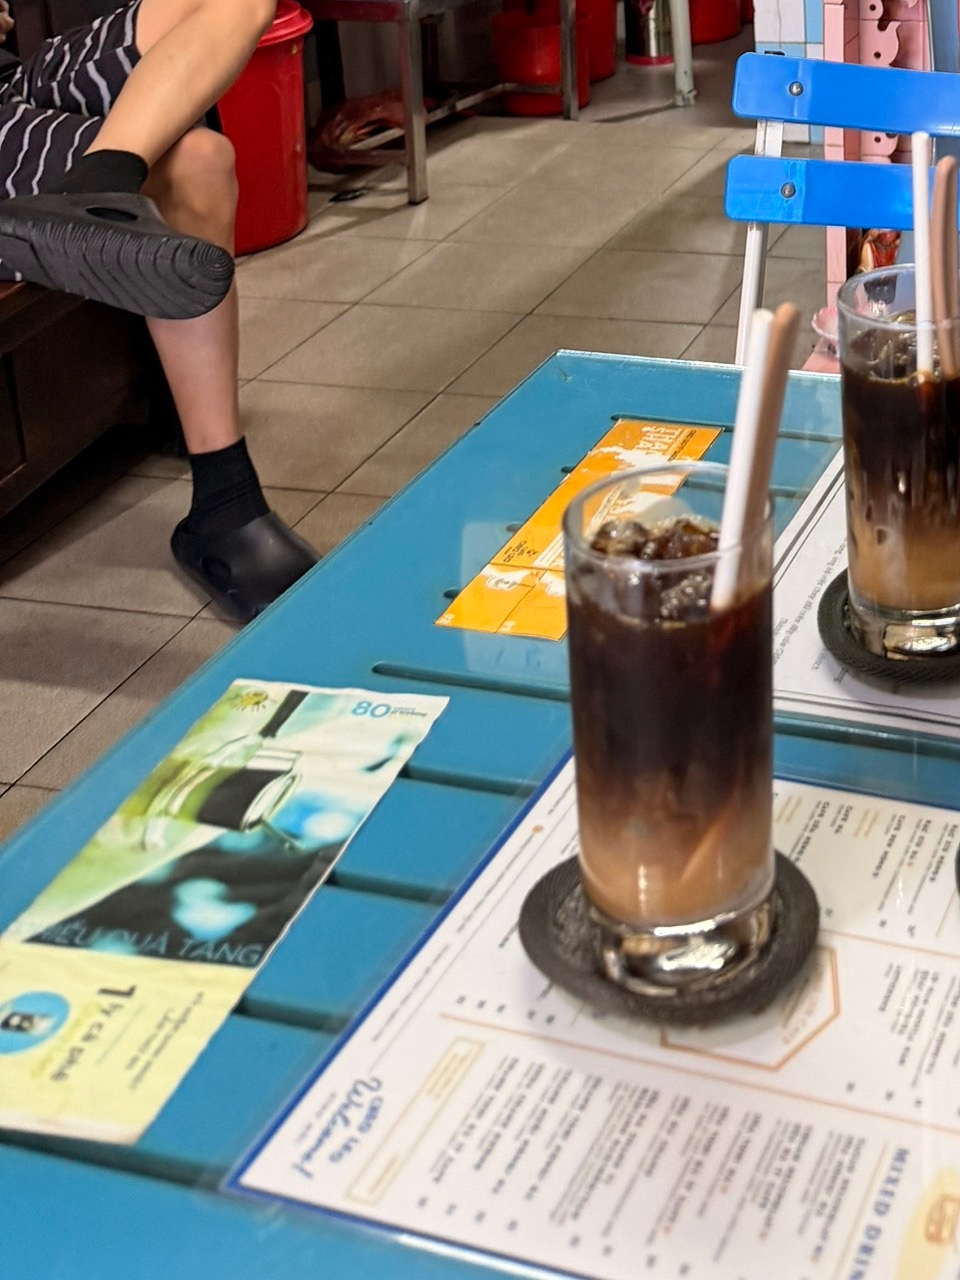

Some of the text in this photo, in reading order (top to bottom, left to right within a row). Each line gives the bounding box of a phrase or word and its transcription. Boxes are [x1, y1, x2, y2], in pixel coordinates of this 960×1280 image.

[351, 700, 391, 718] 80
[98, 984, 137, 998] 1
[873, 1146, 912, 1218] MIXED
